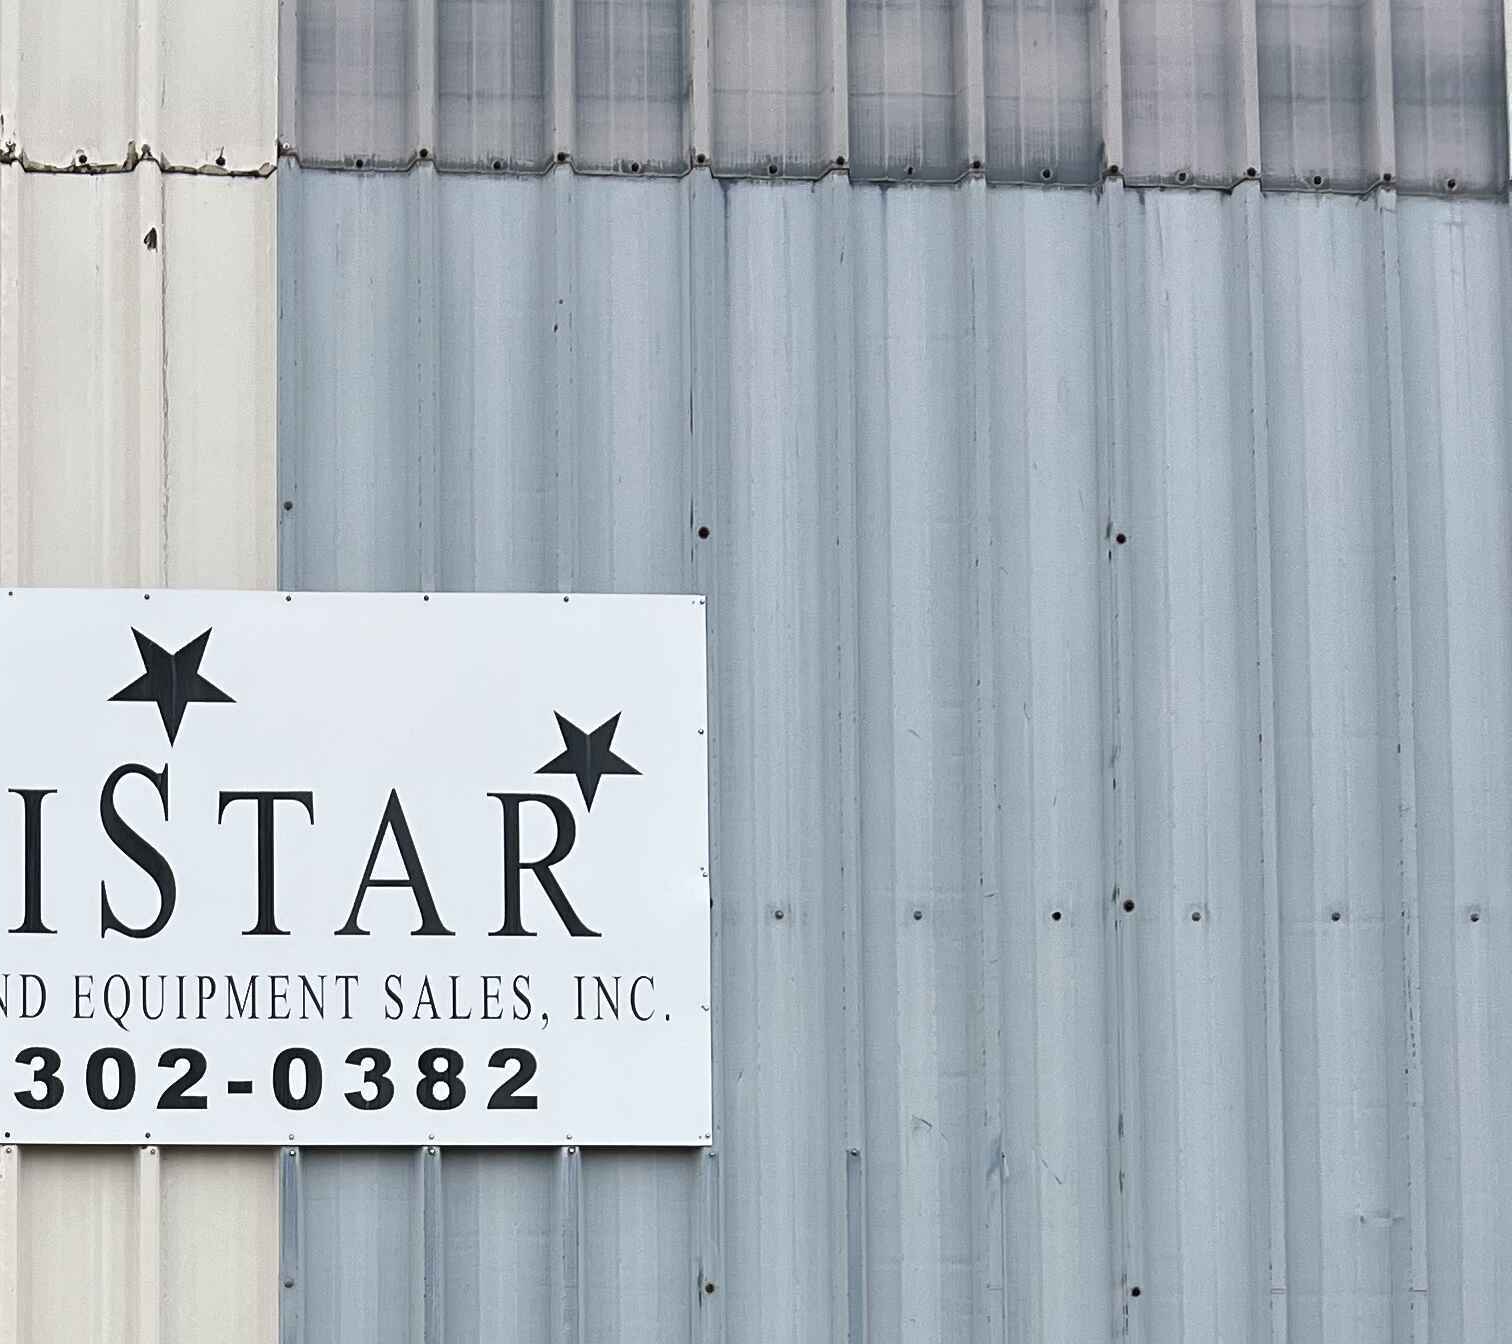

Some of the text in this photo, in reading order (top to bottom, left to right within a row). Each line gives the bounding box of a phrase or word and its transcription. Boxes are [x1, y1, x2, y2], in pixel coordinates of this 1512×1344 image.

[72, 974, 360, 1033] EQUIPMENT
[384, 974, 550, 1030] SALES,
[574, 975, 672, 1023] INC.
